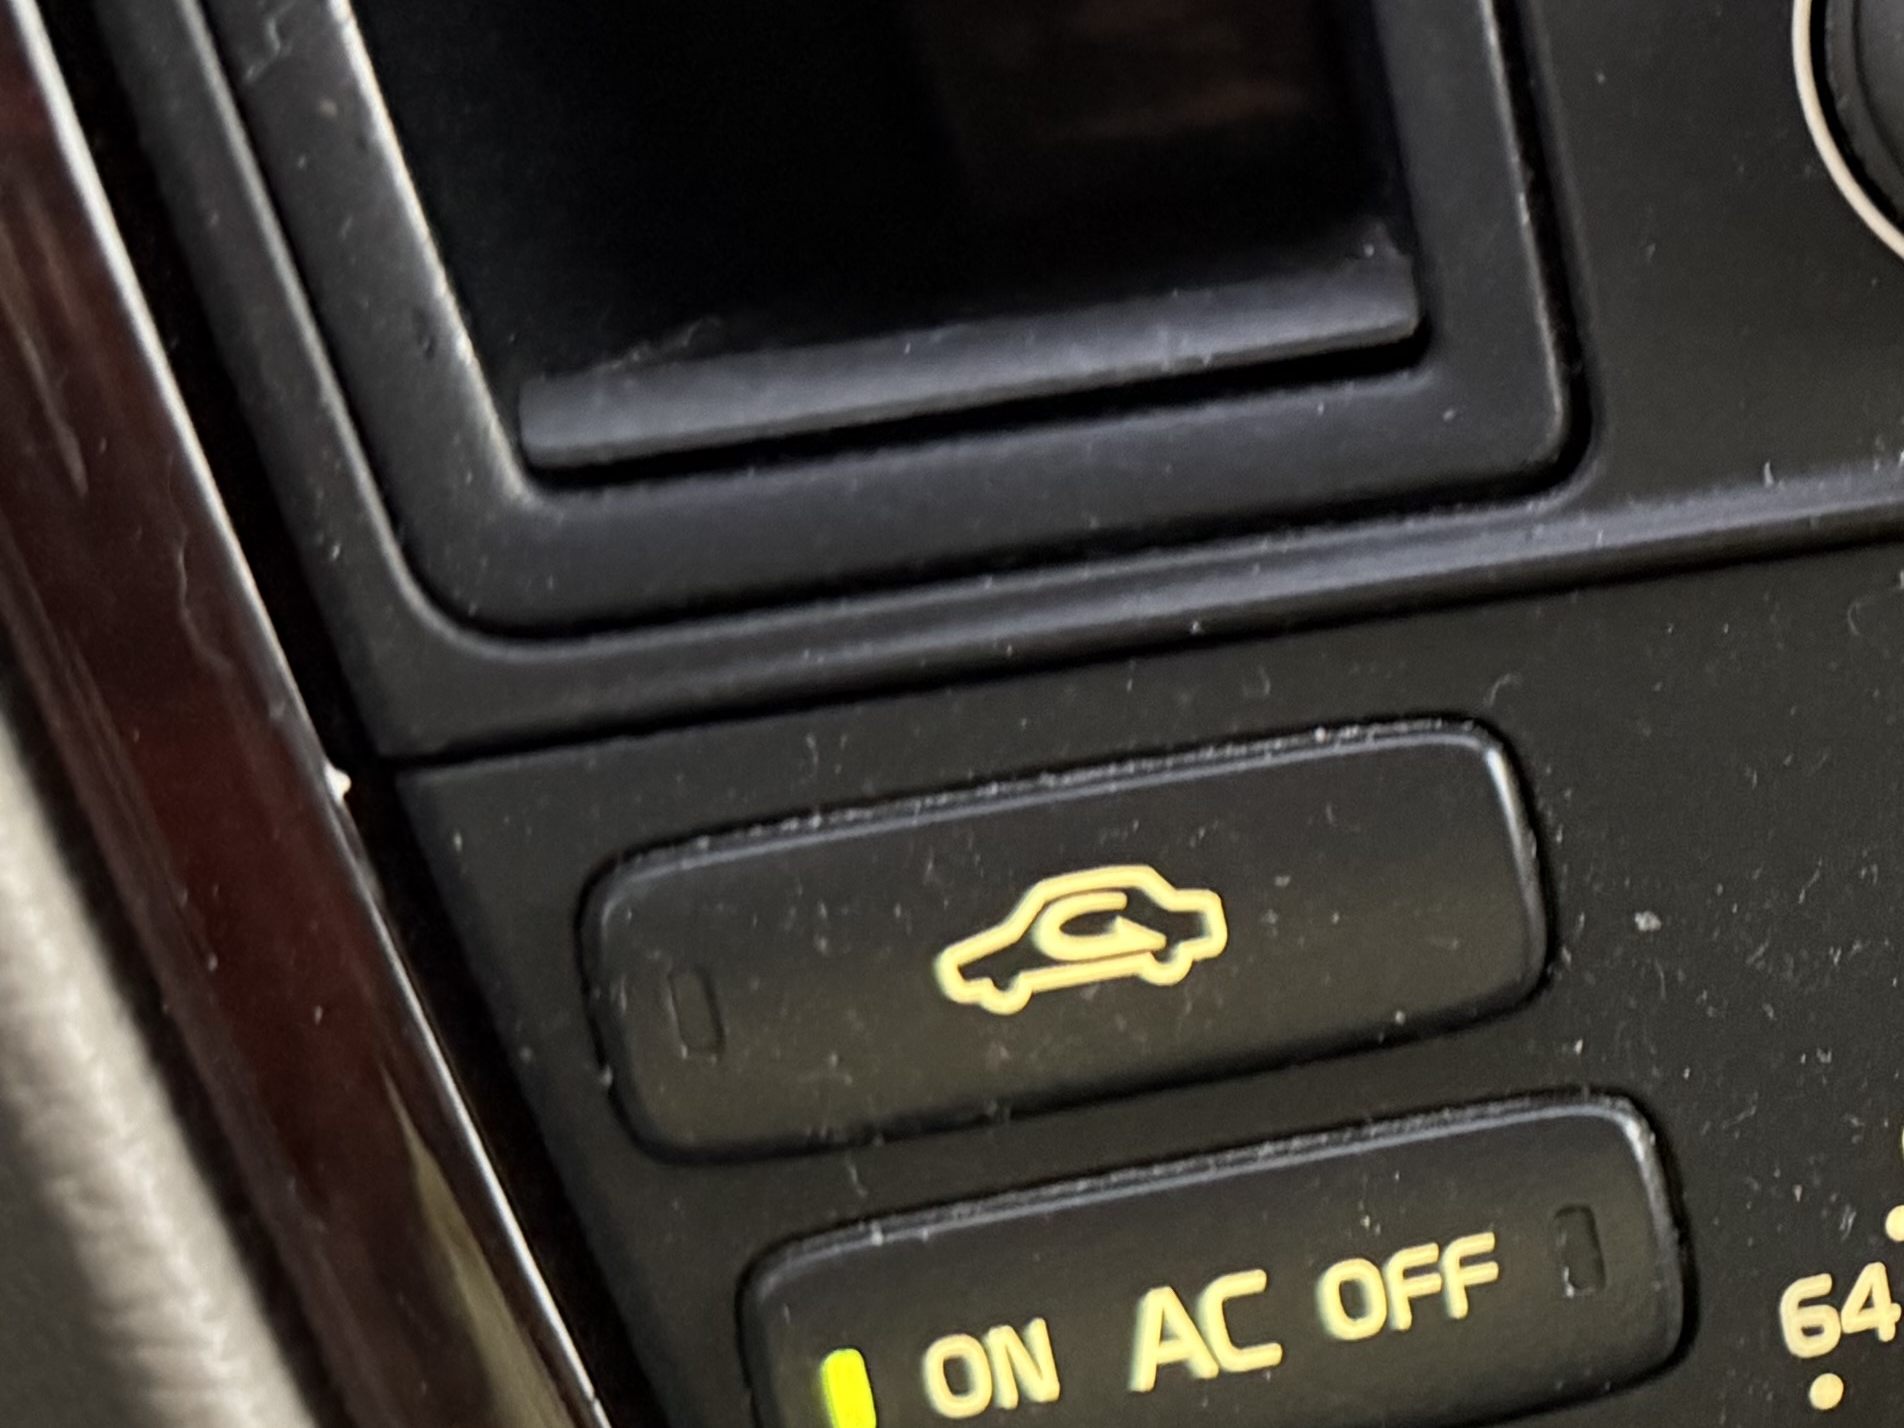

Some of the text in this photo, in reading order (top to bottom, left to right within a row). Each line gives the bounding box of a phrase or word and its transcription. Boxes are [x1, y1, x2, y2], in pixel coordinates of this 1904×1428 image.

[922, 1231, 1499, 1420] ON AC OFF
[1780, 1262, 1902, 1358] 64
